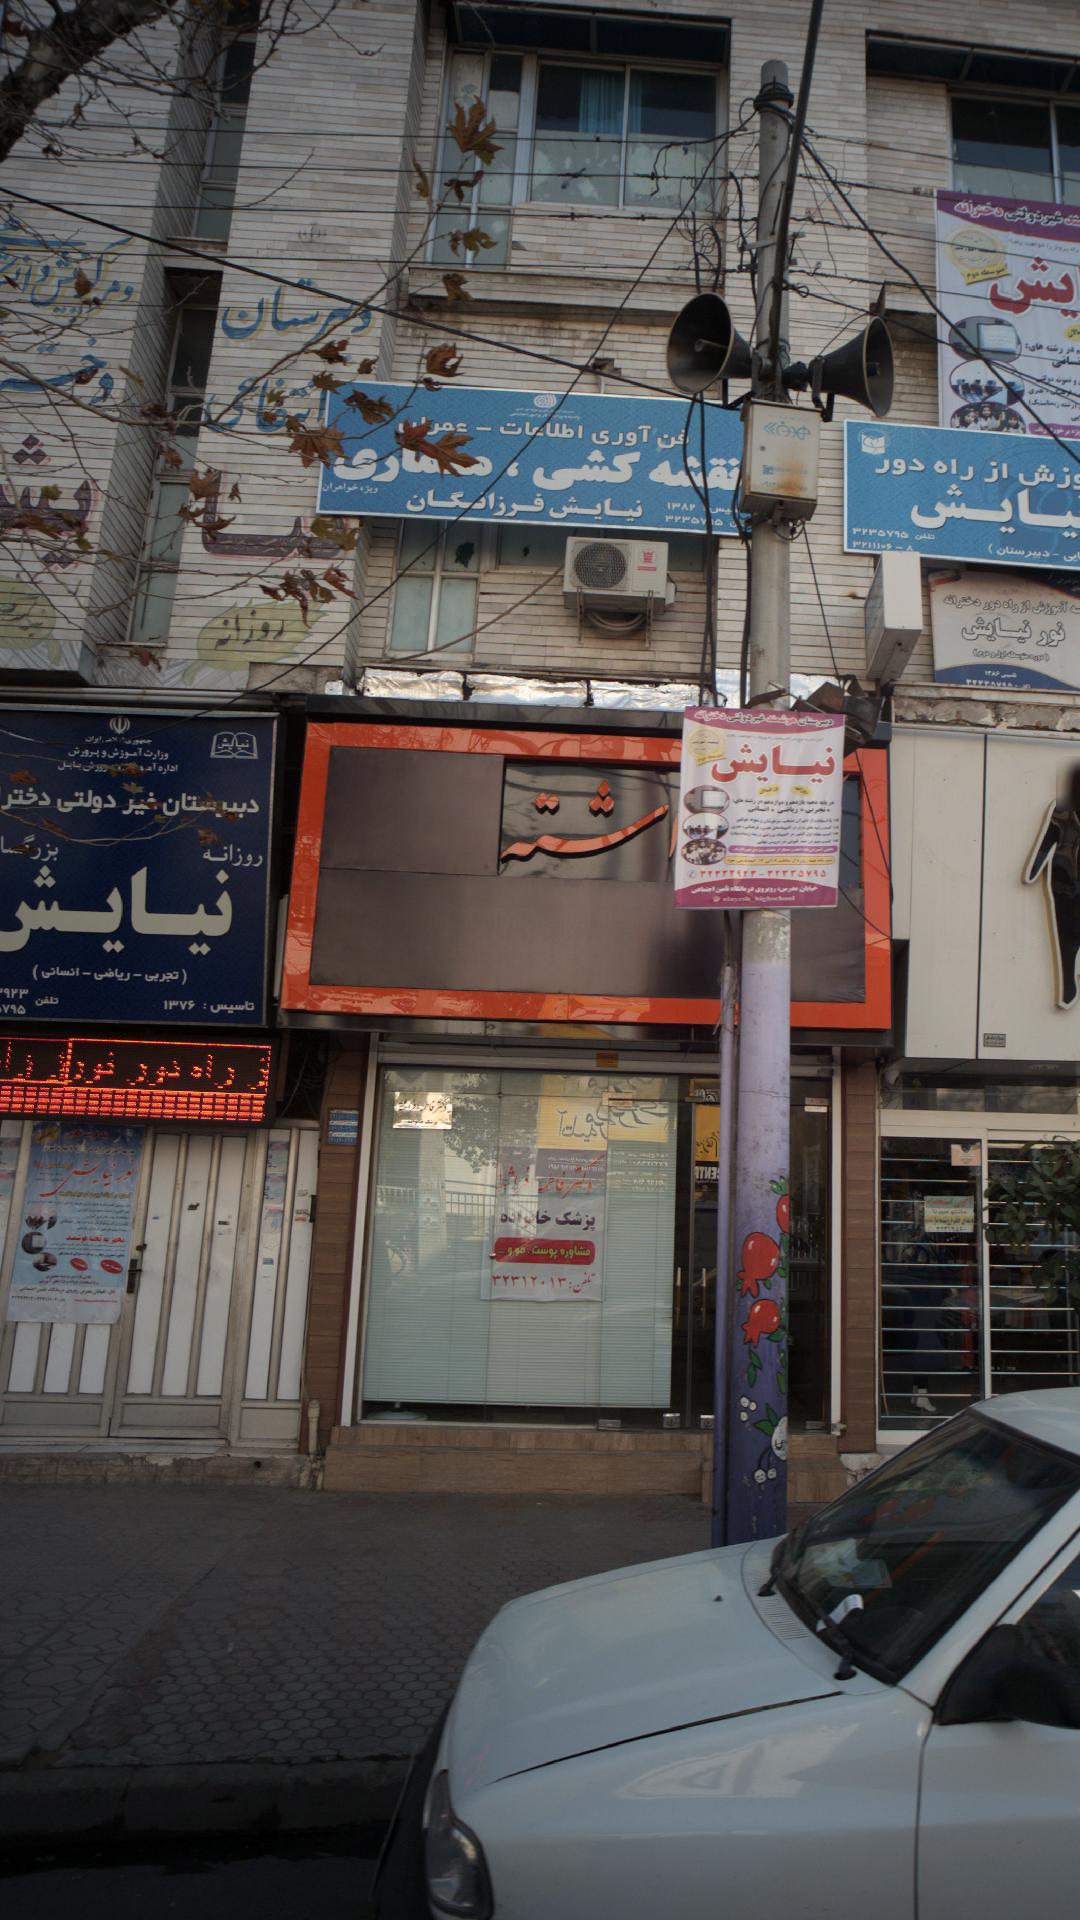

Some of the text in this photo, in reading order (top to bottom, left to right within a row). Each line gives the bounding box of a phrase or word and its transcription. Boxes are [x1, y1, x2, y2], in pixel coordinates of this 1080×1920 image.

[499, 422, 584, 440] اطلاعات
[590, 425, 652, 447] آوری
[656, 427, 690, 449] فن
[332, 447, 493, 483] مماری
[532, 449, 641, 493] کشی
[875, 457, 927, 477] دور
[933, 457, 974, 483] راه
[984, 461, 1009, 484] از
[321, 481, 359, 496] خواهران
[405, 489, 643, 519] نیایش فرزانگان
[665, 515, 724, 527] ۳۲۳۵۷۵
[961, 616, 1067, 648] نور نیایش
[67, 745, 101, 759] پرورش
[108, 746, 143, 760] آموزش
[143, 748, 169, 761] وزارت
[711, 743, 836, 783] نیایش
[157, 762, 180, 775] اداره
[56, 789, 117, 814] دولتی
[122, 791, 159, 816] غیر
[202, 843, 264, 868] روزانه
[0, 864, 234, 957] نیایش
[93, 966, 131, 982] ریاضی
[163, 1000, 196, 1012] ۱۳۷۶
[555, 1211, 597, 1232] پزشک
[559, 1245, 594, 1261] مشاوره
